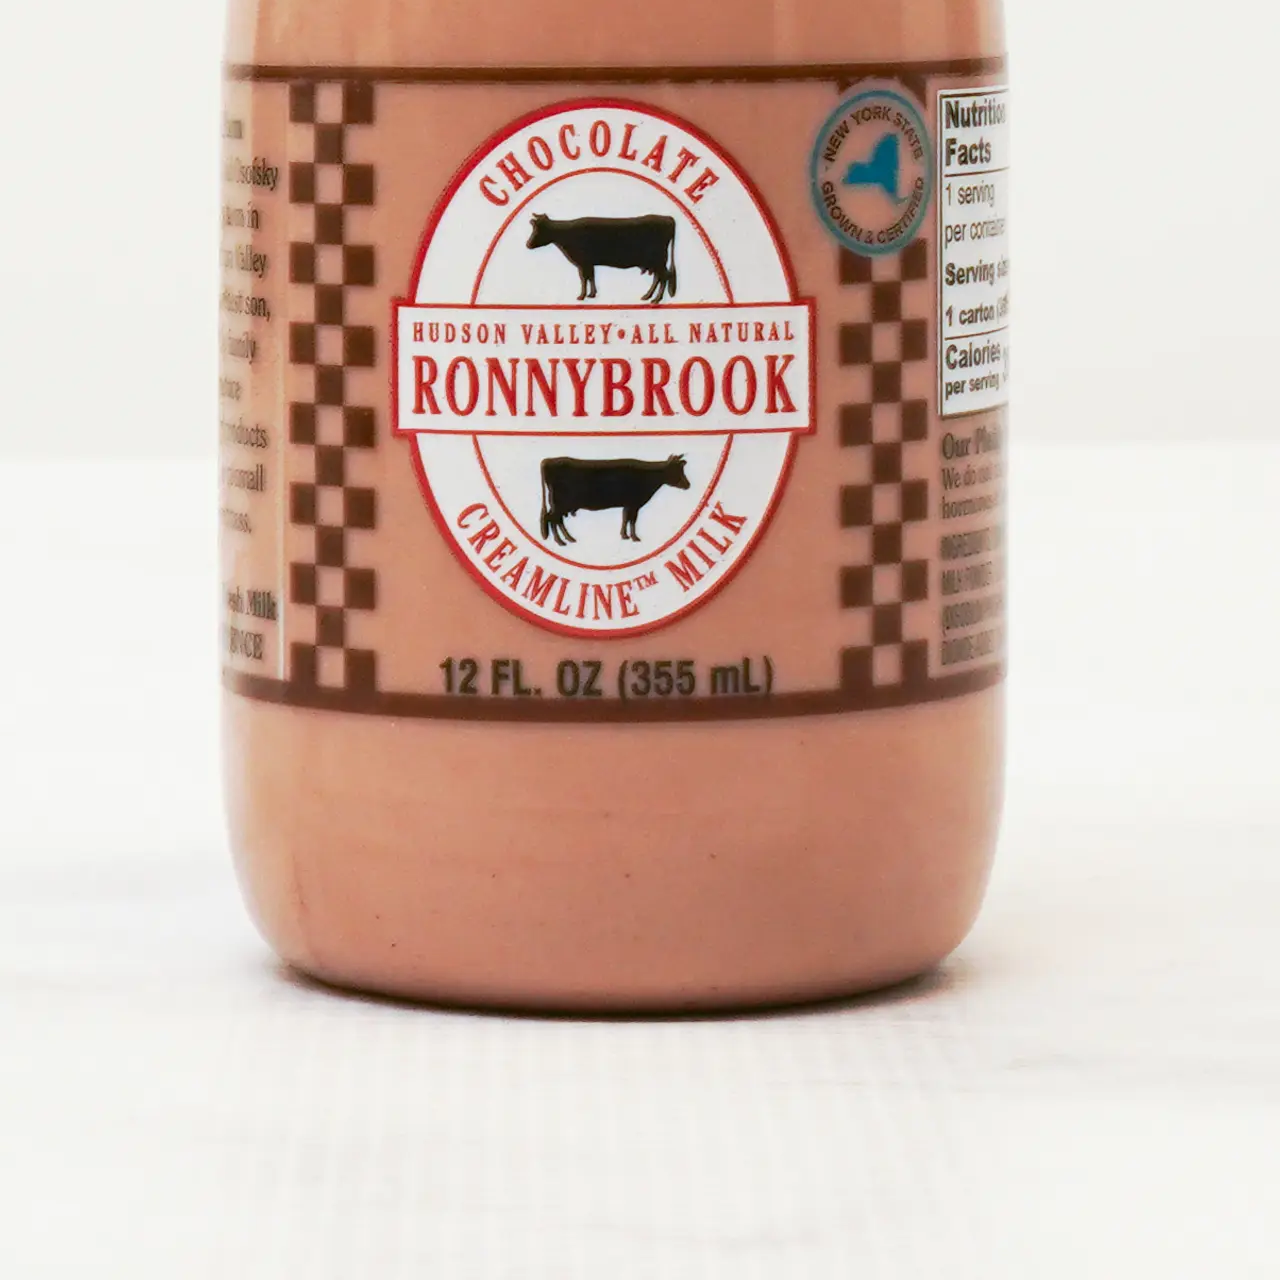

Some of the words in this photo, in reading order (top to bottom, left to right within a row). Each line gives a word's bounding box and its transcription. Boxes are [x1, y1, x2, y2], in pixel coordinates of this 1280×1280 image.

[822, 120, 851, 163] NEW
[850, 104, 892, 125] YORK
[892, 110, 925, 161] STATE
[478, 120, 720, 207] CHOCOLATE
[945, 136, 992, 167] Facts
[945, 182, 953, 206] 1
[957, 180, 995, 208] serving
[821, 180, 863, 243] GROWN
[864, 231, 875, 245] &
[876, 176, 925, 245] CERTIFIED
[944, 223, 967, 249] per
[945, 259, 996, 287] Serving
[945, 305, 954, 327] 1
[959, 301, 995, 325] carton
[412, 321, 507, 345] HUDSON
[688, 320, 796, 343] NATURAL
[945, 339, 1001, 370] Calories
[411, 353, 798, 418] RONNYBROOK
[945, 379, 967, 400] per
[663, 500, 748, 593] MILK
[439, 657, 479, 695] 12
[490, 658, 541, 697] FL.
[556, 659, 603, 697] OZ
[619, 657, 696, 700] (355
[710, 655, 775, 698] mL)
